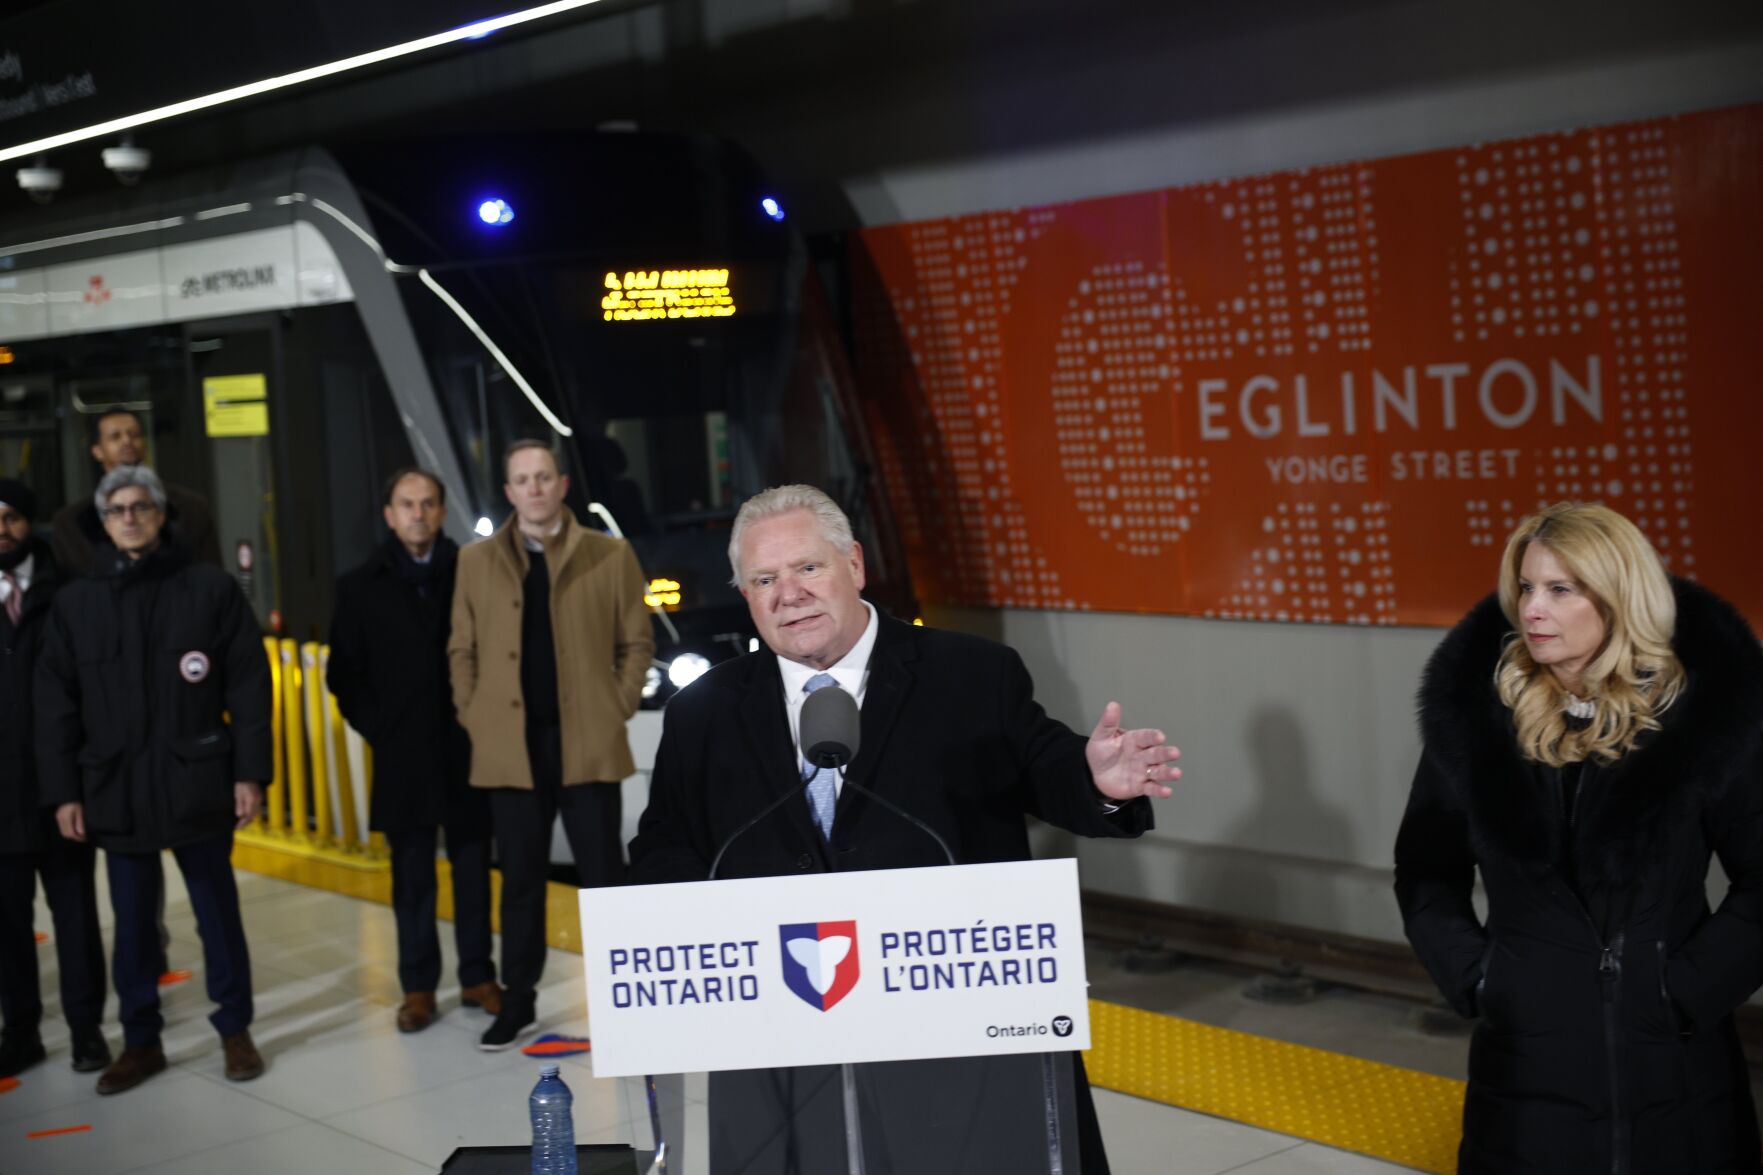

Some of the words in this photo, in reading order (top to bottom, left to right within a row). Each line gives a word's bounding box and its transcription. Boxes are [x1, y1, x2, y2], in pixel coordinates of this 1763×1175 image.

[1198, 355, 1603, 440] EGLINTON
[1266, 454, 1369, 484] YONGE
[1391, 449, 1521, 480] STREET
[880, 918, 1058, 960] PROTÉGER
[609, 940, 760, 976] PROTECT
[883, 956, 1059, 993] L'ONTARIO
[612, 974, 760, 1009] ONTARIO
[986, 1021, 1049, 1039] Ontario
